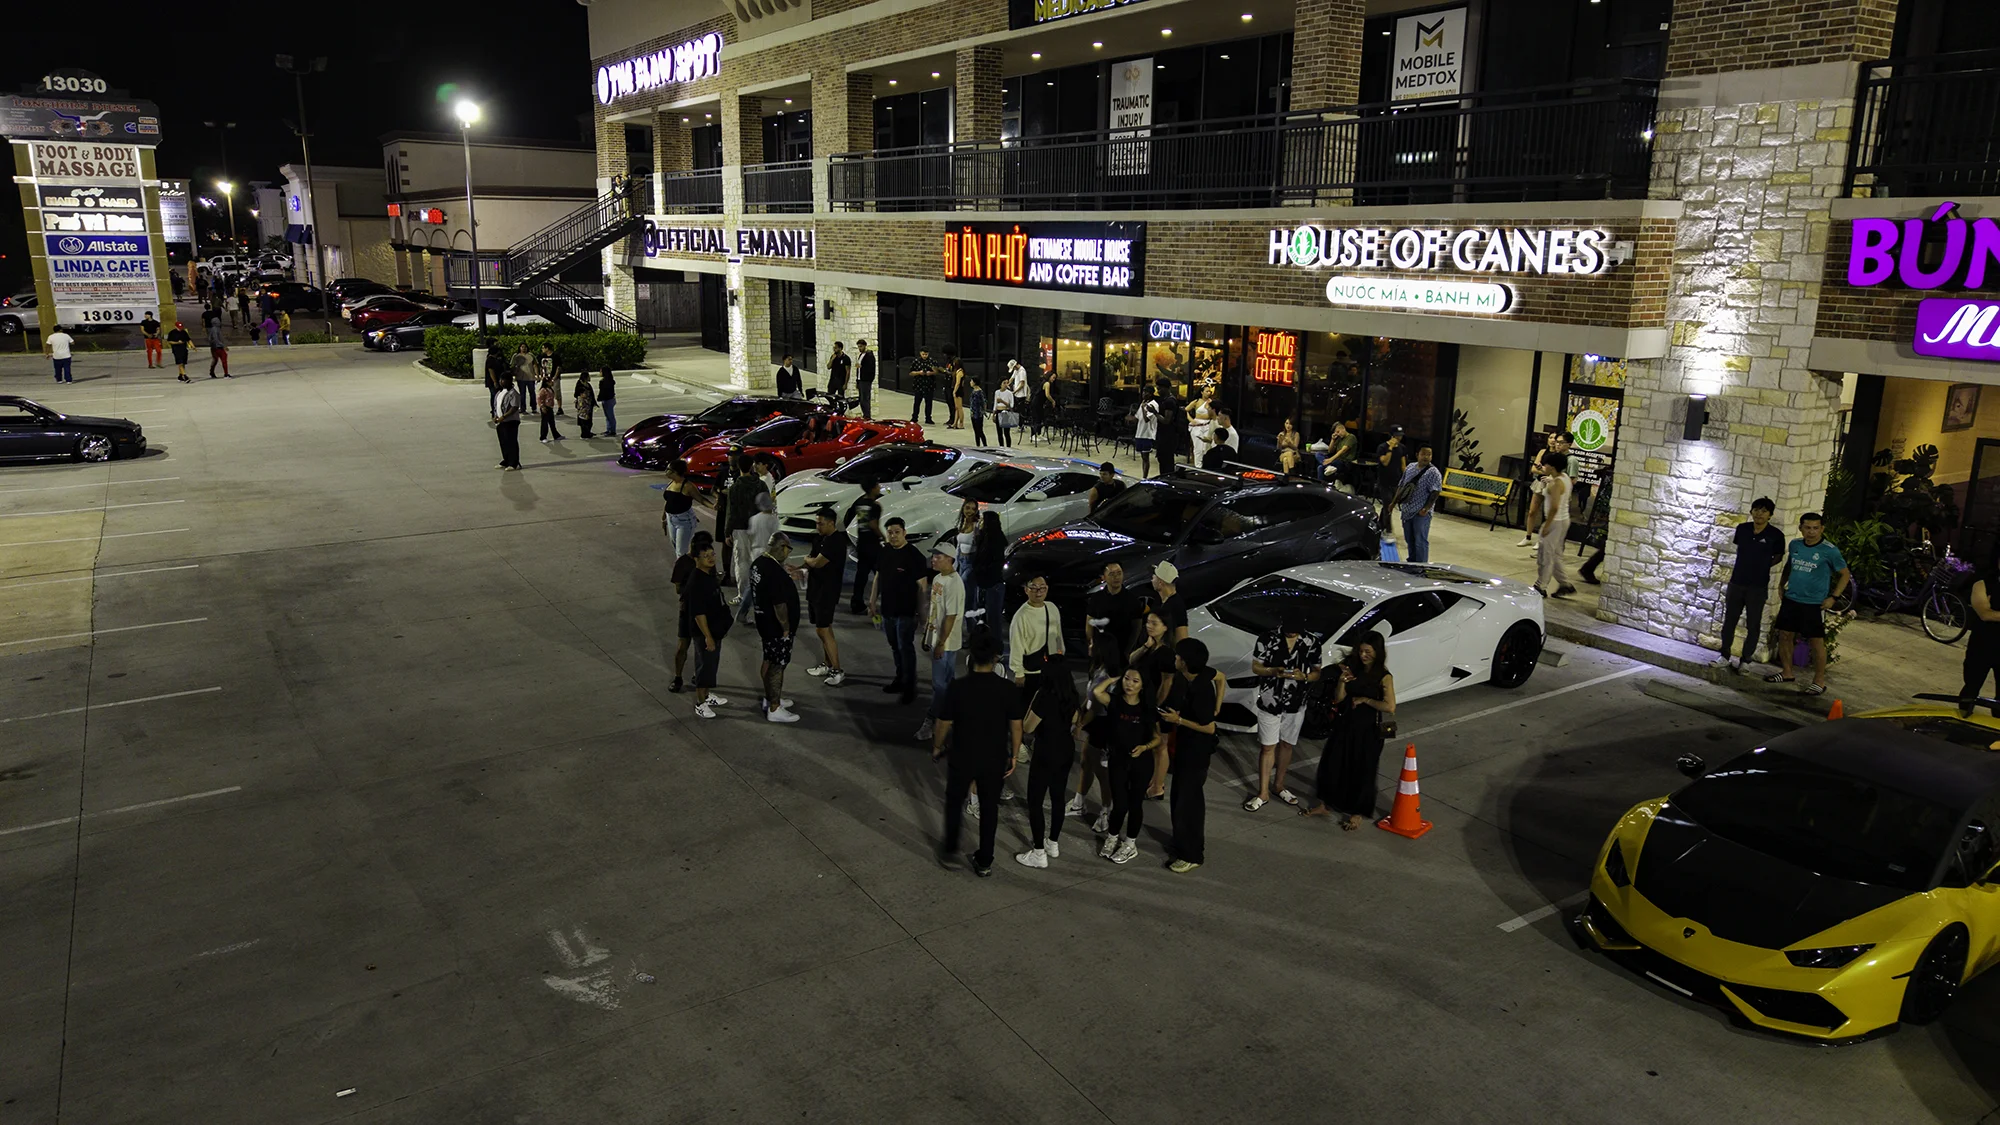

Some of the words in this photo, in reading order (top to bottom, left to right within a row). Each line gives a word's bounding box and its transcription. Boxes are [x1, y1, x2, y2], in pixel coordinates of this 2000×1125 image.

[1034, 0, 1115, 22] MEDI
[676, 33, 722, 83] SPOT
[1400, 52, 1455, 71] MOBILE
[42, 76, 107, 93] 13030
[1395, 70, 1457, 90] MEDTOX
[12, 99, 88, 110] LONGHORN
[92, 103, 140, 113] DIESEL
[1112, 94, 1150, 111] TRAUMATIC
[1117, 112, 1144, 128] INJURY
[36, 144, 78, 160] FOOT
[81, 150, 90, 160] &
[92, 147, 134, 161] BODY
[38, 160, 137, 177] MASSAGE
[86, 241, 138, 252] Allstate
[963, 226, 981, 279] ĂN
[986, 224, 1027, 281] PHỞ
[1029, 237, 1072, 260] VIETNAMESE
[1073, 238, 1103, 261] NOODLE
[1104, 240, 1131, 263] HOUSE
[1268, 225, 1381, 267] HOUSE
[1390, 229, 1444, 269] OF
[1453, 229, 1602, 274] CANES
[1848, 201, 2000, 290] BÚN
[53, 260, 104, 273] LINDA
[106, 260, 150, 273] CAFE
[1029, 263, 1052, 282] AND
[1055, 264, 1099, 285] COFFEE
[1102, 266, 1129, 287] BAR
[1381, 287, 1408, 301] MÍA
[1426, 288, 1470, 305] BÁNH
[83, 310, 133, 322] 13030
[1150, 320, 1192, 341] OPEN
[1586, 451, 1606, 459] ACCEPTED
